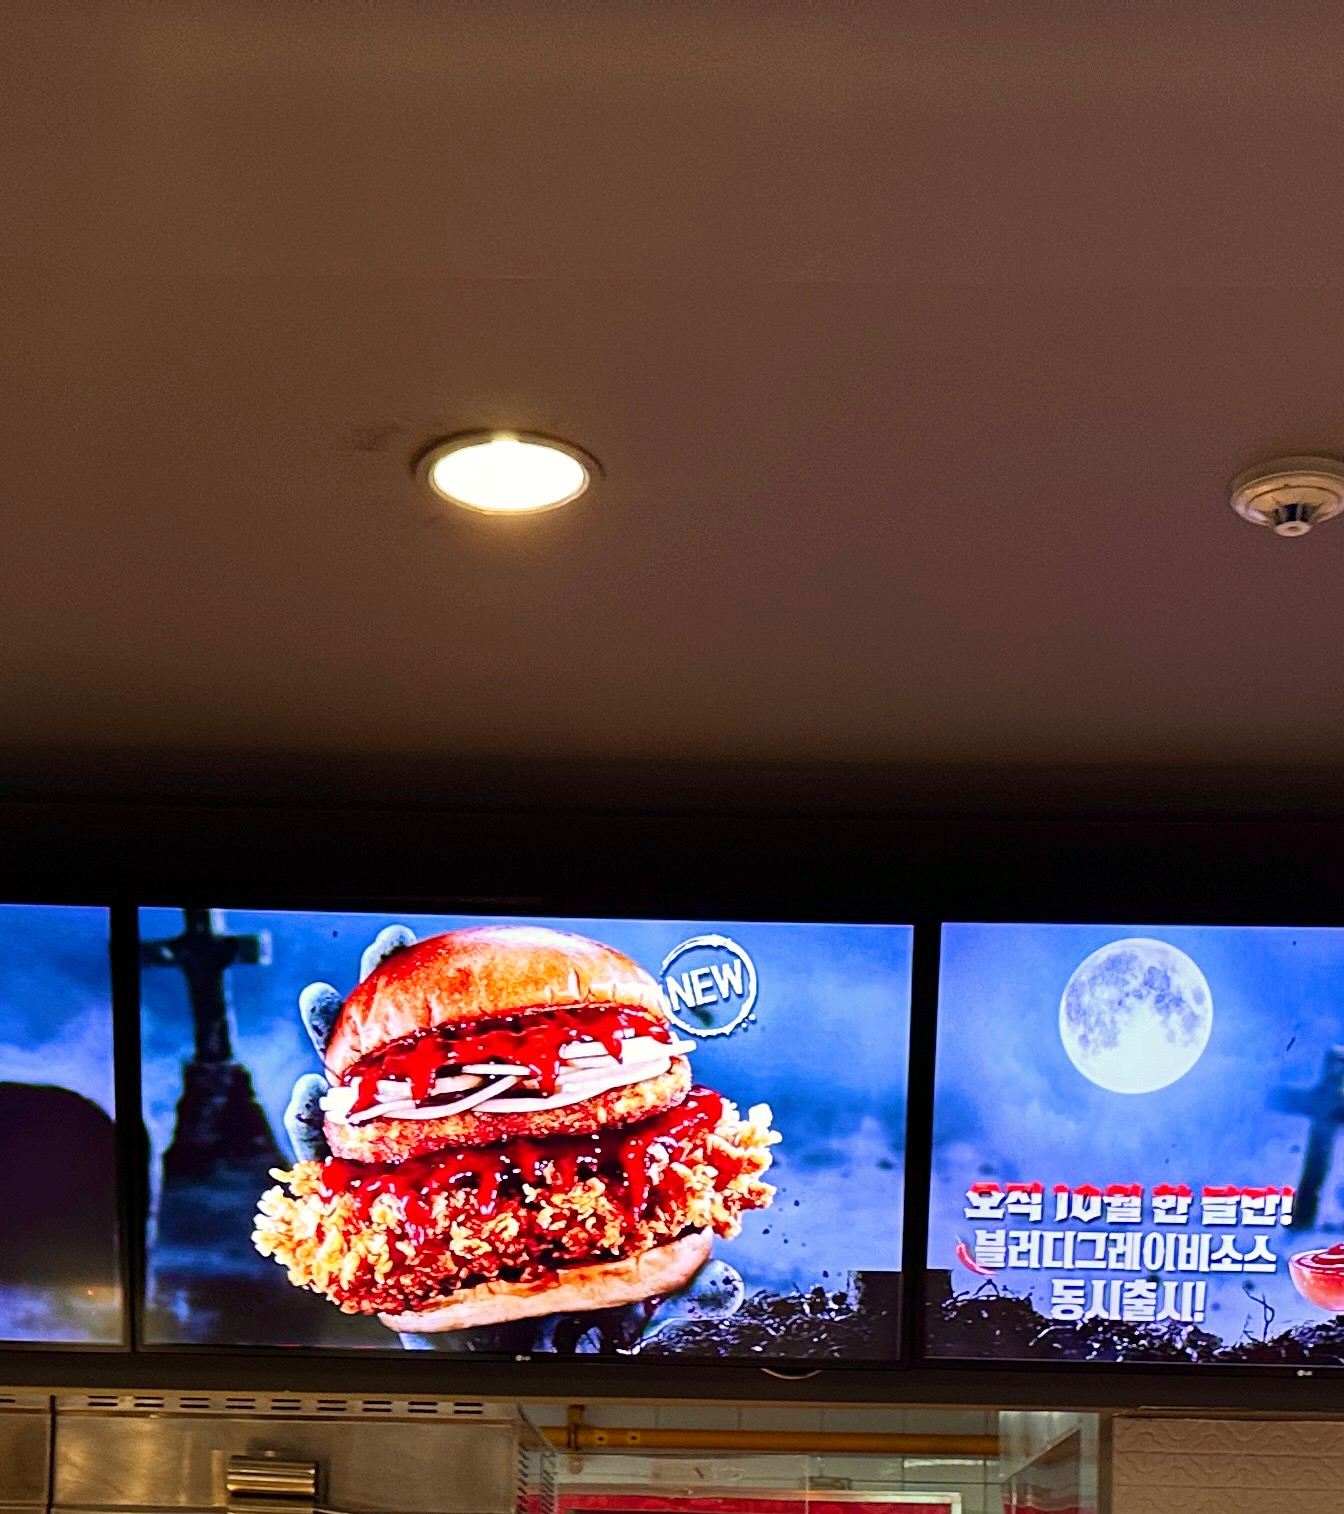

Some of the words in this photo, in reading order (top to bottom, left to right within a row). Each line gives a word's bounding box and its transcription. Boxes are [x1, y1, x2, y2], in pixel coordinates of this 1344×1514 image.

[665, 959, 744, 1012] NEW
[964, 1181, 1043, 1222] 오직
[1053, 1183, 1143, 1225] 10월
[1151, 1184, 1194, 1226] 한
[1199, 1186, 1295, 1228] 달만!
[974, 1228, 1278, 1274] 블러디그레이비소스
[1050, 1279, 1207, 1323] 동시출시!
